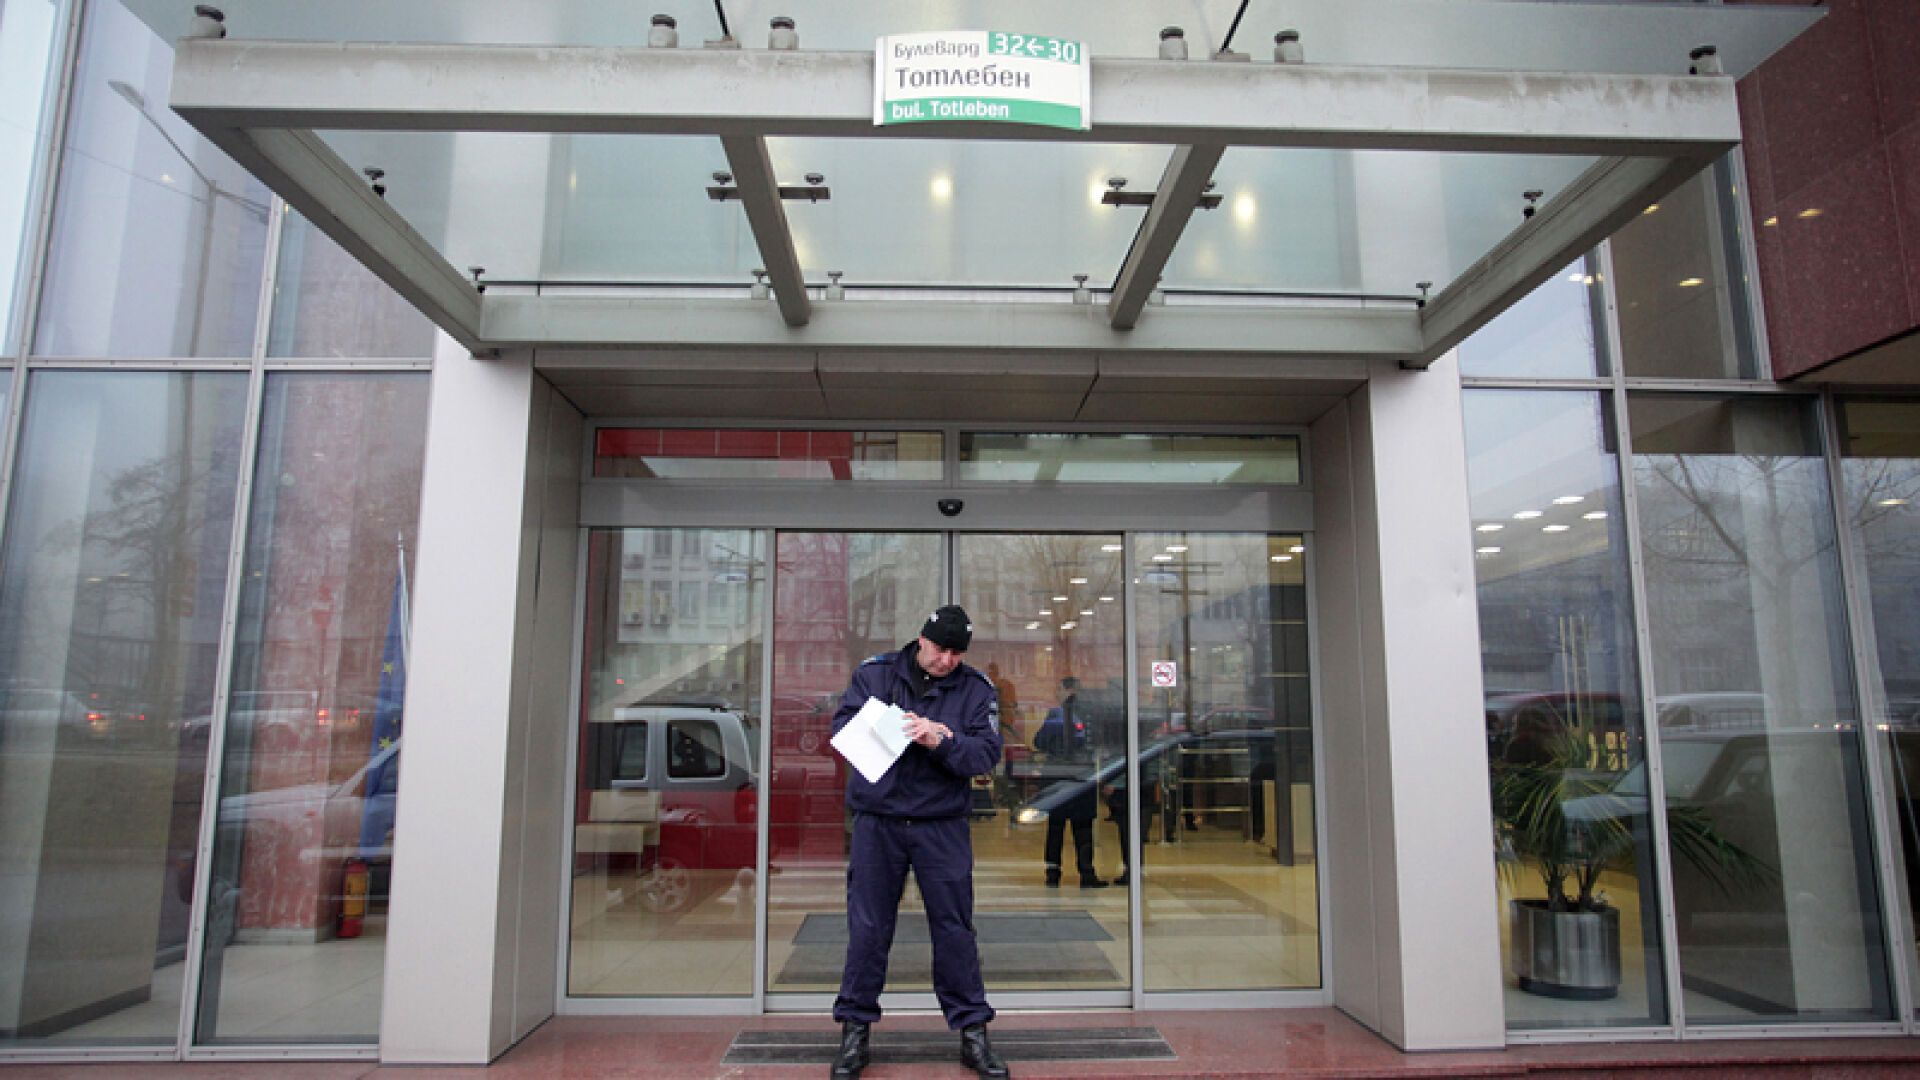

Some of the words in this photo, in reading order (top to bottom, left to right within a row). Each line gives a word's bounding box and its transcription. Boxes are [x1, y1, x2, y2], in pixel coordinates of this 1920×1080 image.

[995, 32, 1024, 56] 32
[1048, 40, 1077, 64] 30
[894, 64, 1031, 89] Тотлебен
[892, 102, 925, 119] bul.
[929, 100, 1009, 118] Totleben
